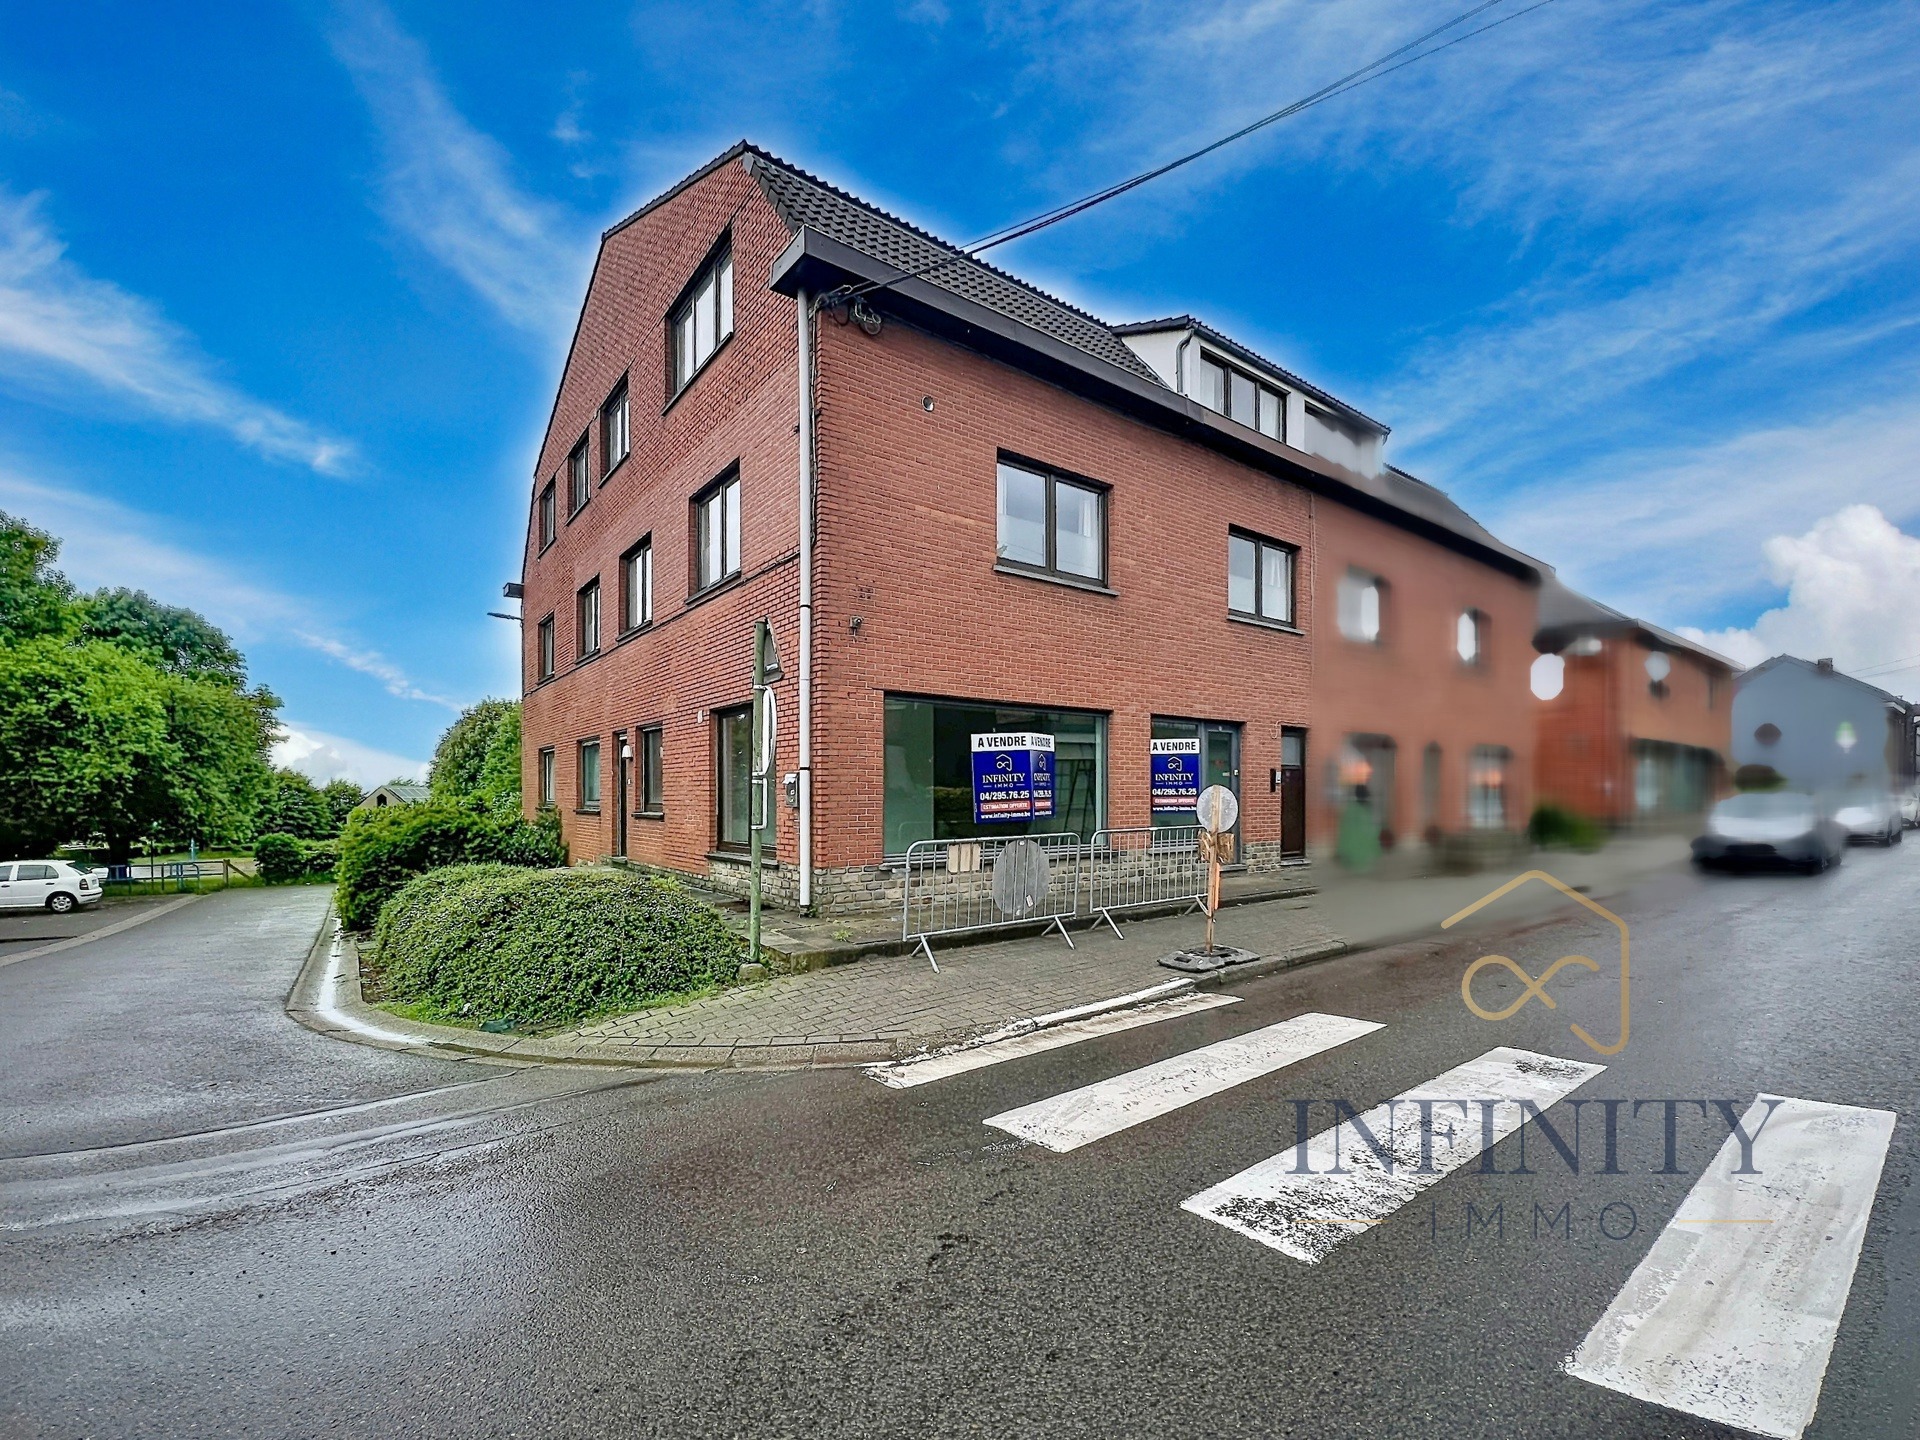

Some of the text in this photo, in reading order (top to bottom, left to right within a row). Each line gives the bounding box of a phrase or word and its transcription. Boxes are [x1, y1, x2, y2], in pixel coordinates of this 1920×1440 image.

[978, 736, 1026, 748] A VENDRE
[1152, 742, 1196, 751] A VENDRE
[982, 772, 1025, 783] INFINITY
[980, 790, 1030, 800] 04/295.76.25
[1152, 788, 1197, 796] 04/295.76.25
